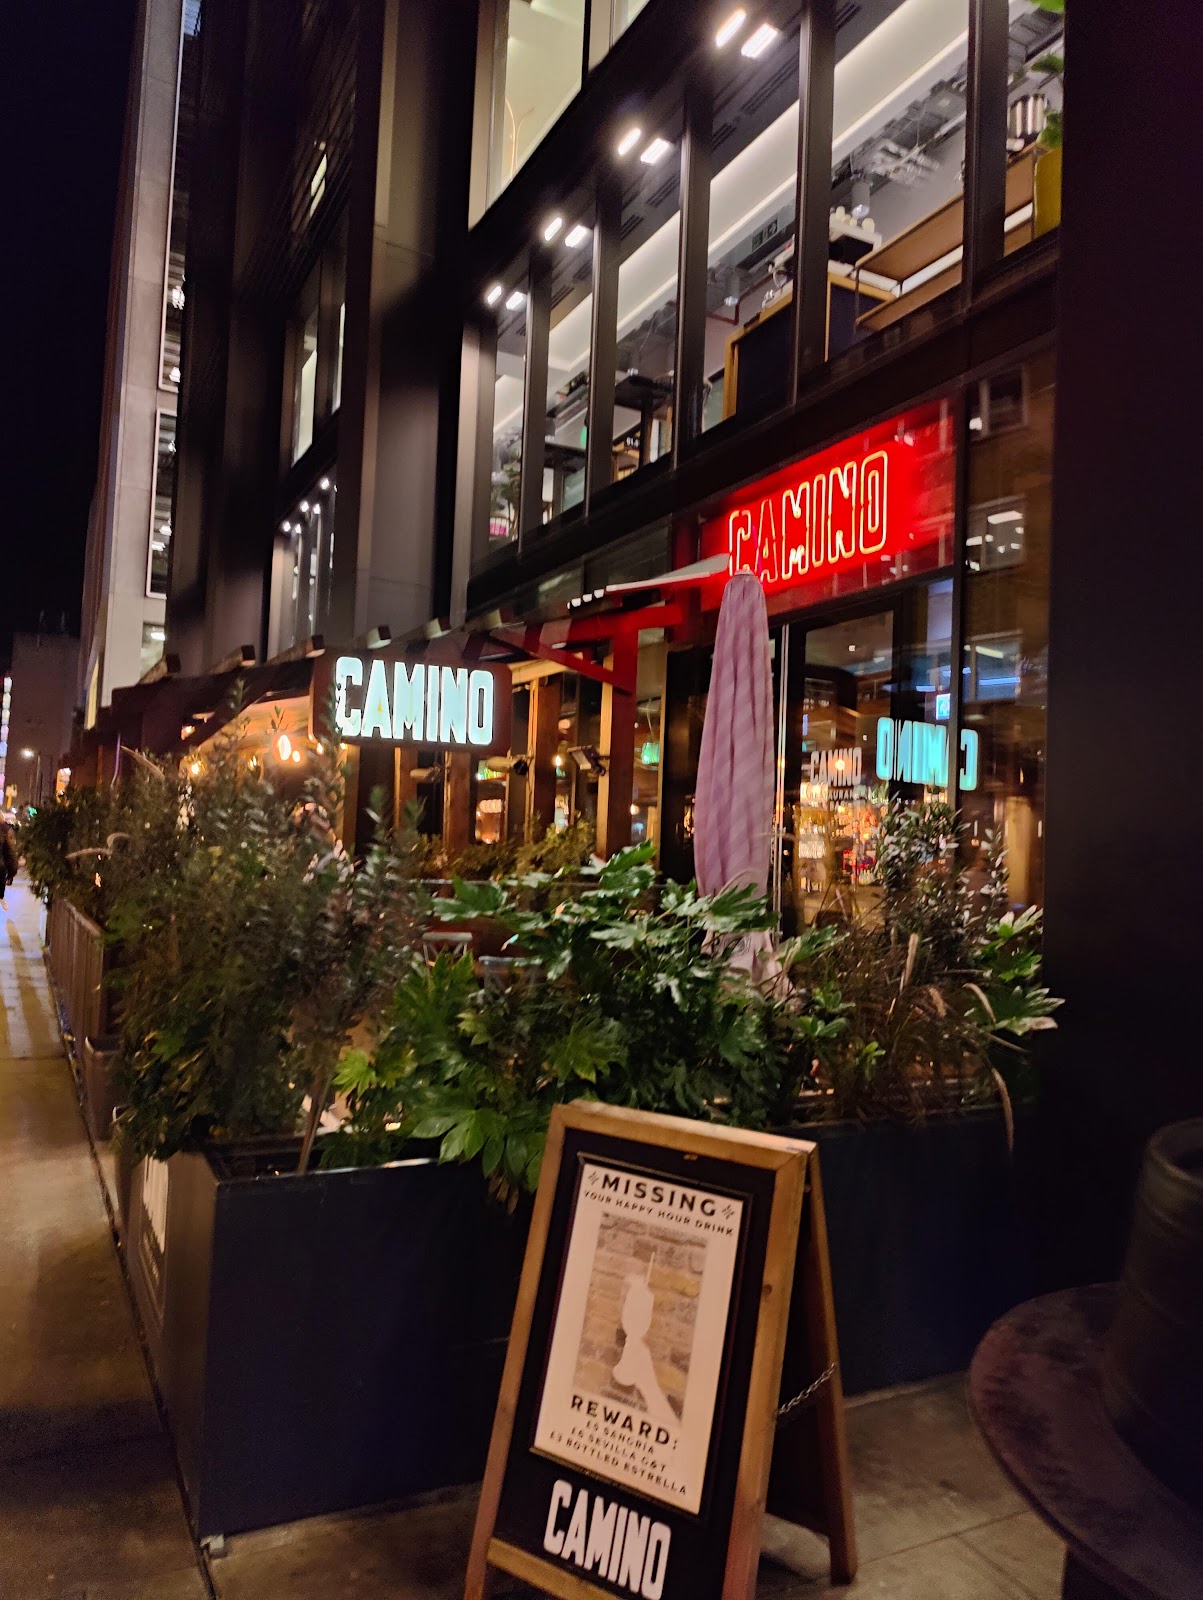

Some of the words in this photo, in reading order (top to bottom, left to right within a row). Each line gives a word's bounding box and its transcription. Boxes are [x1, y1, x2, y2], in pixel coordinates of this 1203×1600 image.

[729, 450, 888, 583] CAMINO
[335, 656, 494, 745] CAMINO
[810, 746, 862, 786] CAMINO
[584, 1190, 612, 1204] YOUR
[615, 1200, 653, 1215] HAPPY
[657, 1210, 691, 1225] HOUR
[695, 1219, 734, 1236] DRINK
[602, 1173, 716, 1217] MISSING
[566, 1438, 619, 1466] BOTTLED
[623, 1462, 687, 1495] ESTRELLA
[589, 1433, 636, 1460] SEVILLA
[543, 1479, 672, 1600] CAMINO
